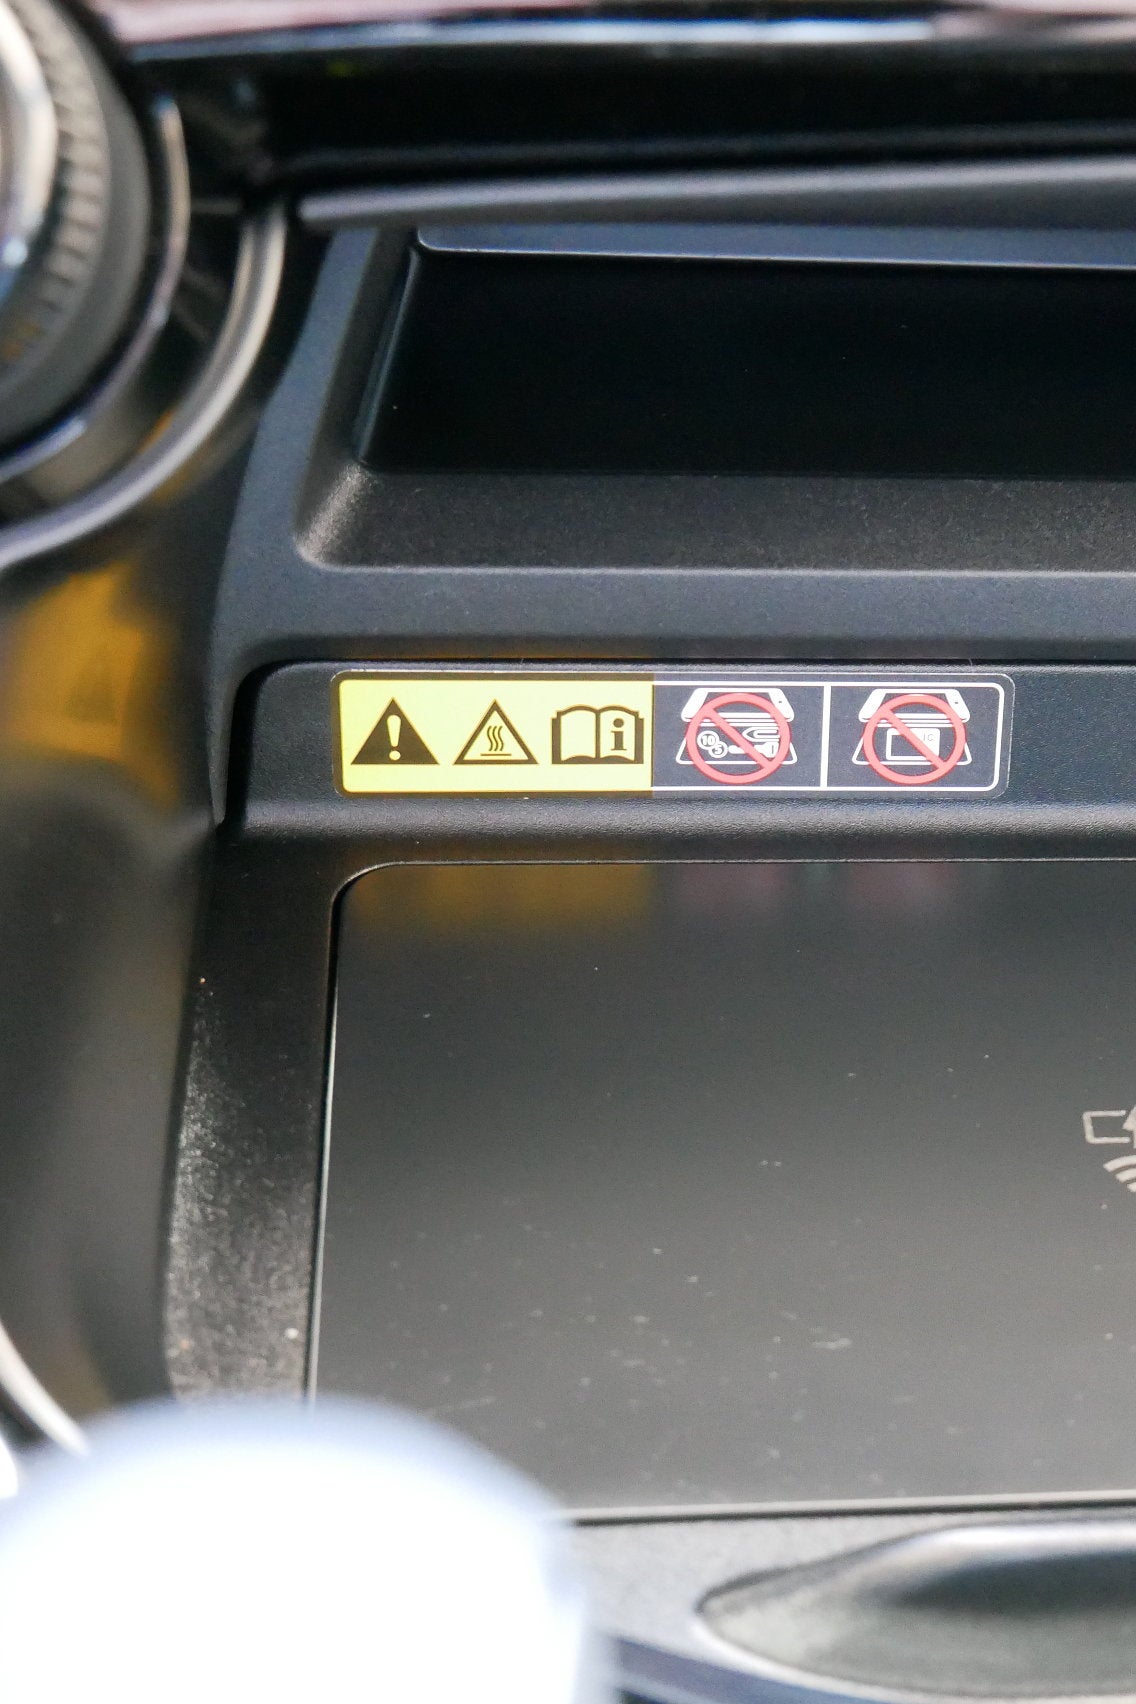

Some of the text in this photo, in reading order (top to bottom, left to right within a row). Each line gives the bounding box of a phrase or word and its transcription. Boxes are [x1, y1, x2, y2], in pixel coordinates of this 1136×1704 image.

[610, 718, 627, 751] i
[702, 734, 716, 746] 10
[923, 733, 935, 742] IC
[714, 745, 723, 755] 5
